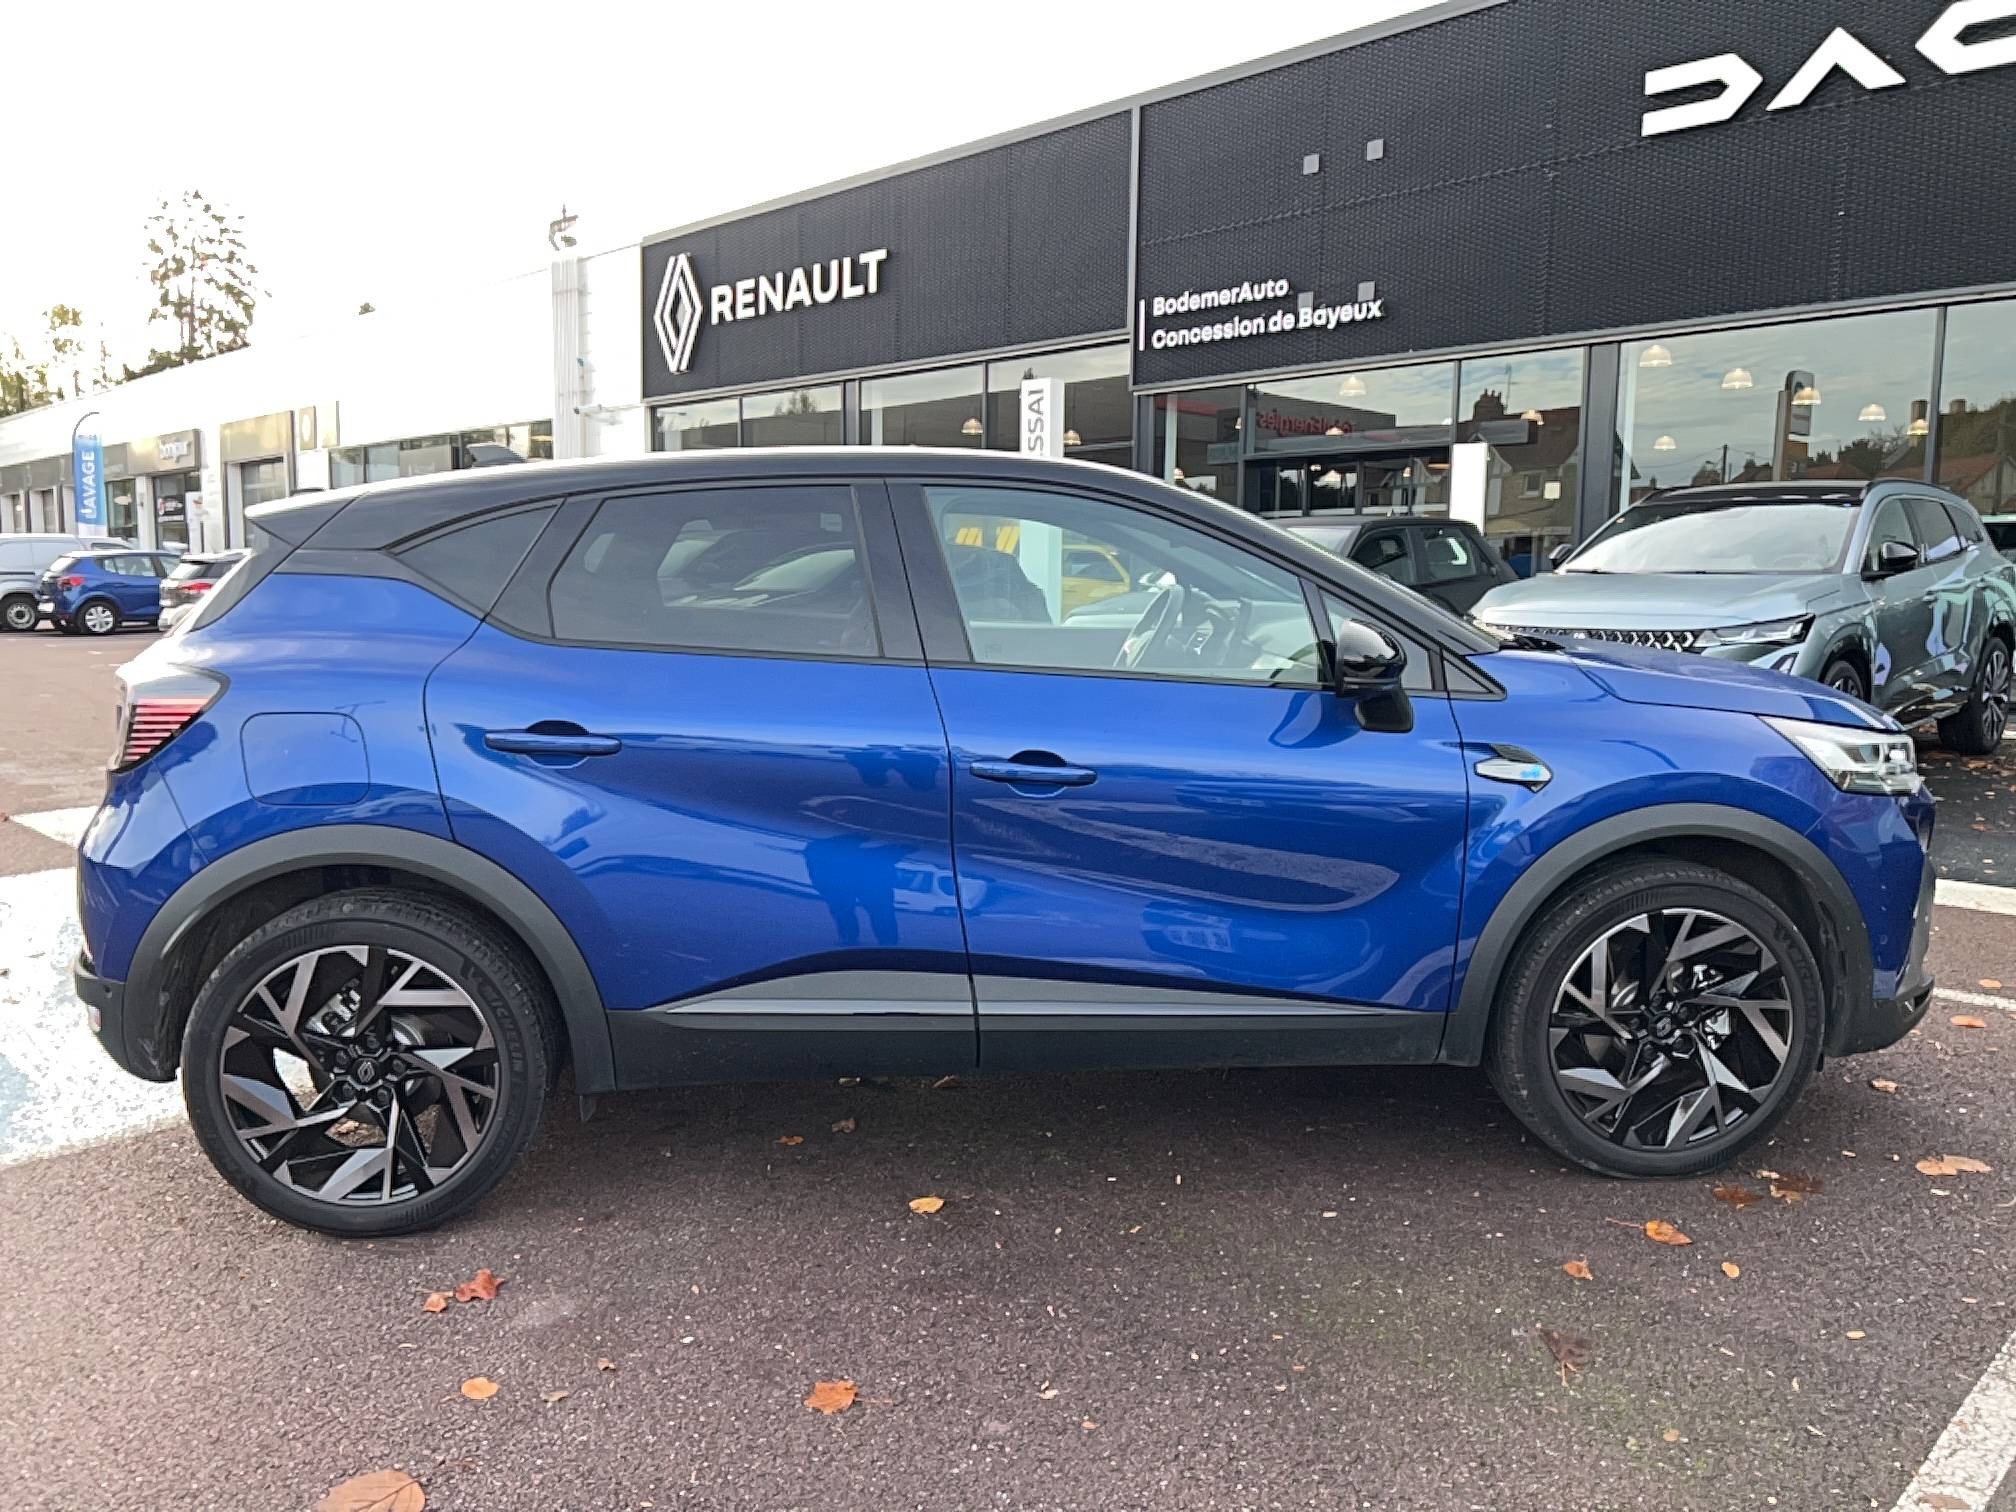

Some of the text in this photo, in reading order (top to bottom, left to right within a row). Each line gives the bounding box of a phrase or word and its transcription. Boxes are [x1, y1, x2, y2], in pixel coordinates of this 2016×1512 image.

[711, 248, 888, 325] RENAULT
[1152, 279, 1289, 317] BodemerAuto
[1151, 298, 1384, 349] Concession de Bayeux
[1028, 388, 1045, 456] SSAI
[80, 451, 97, 519] LAVAGE
